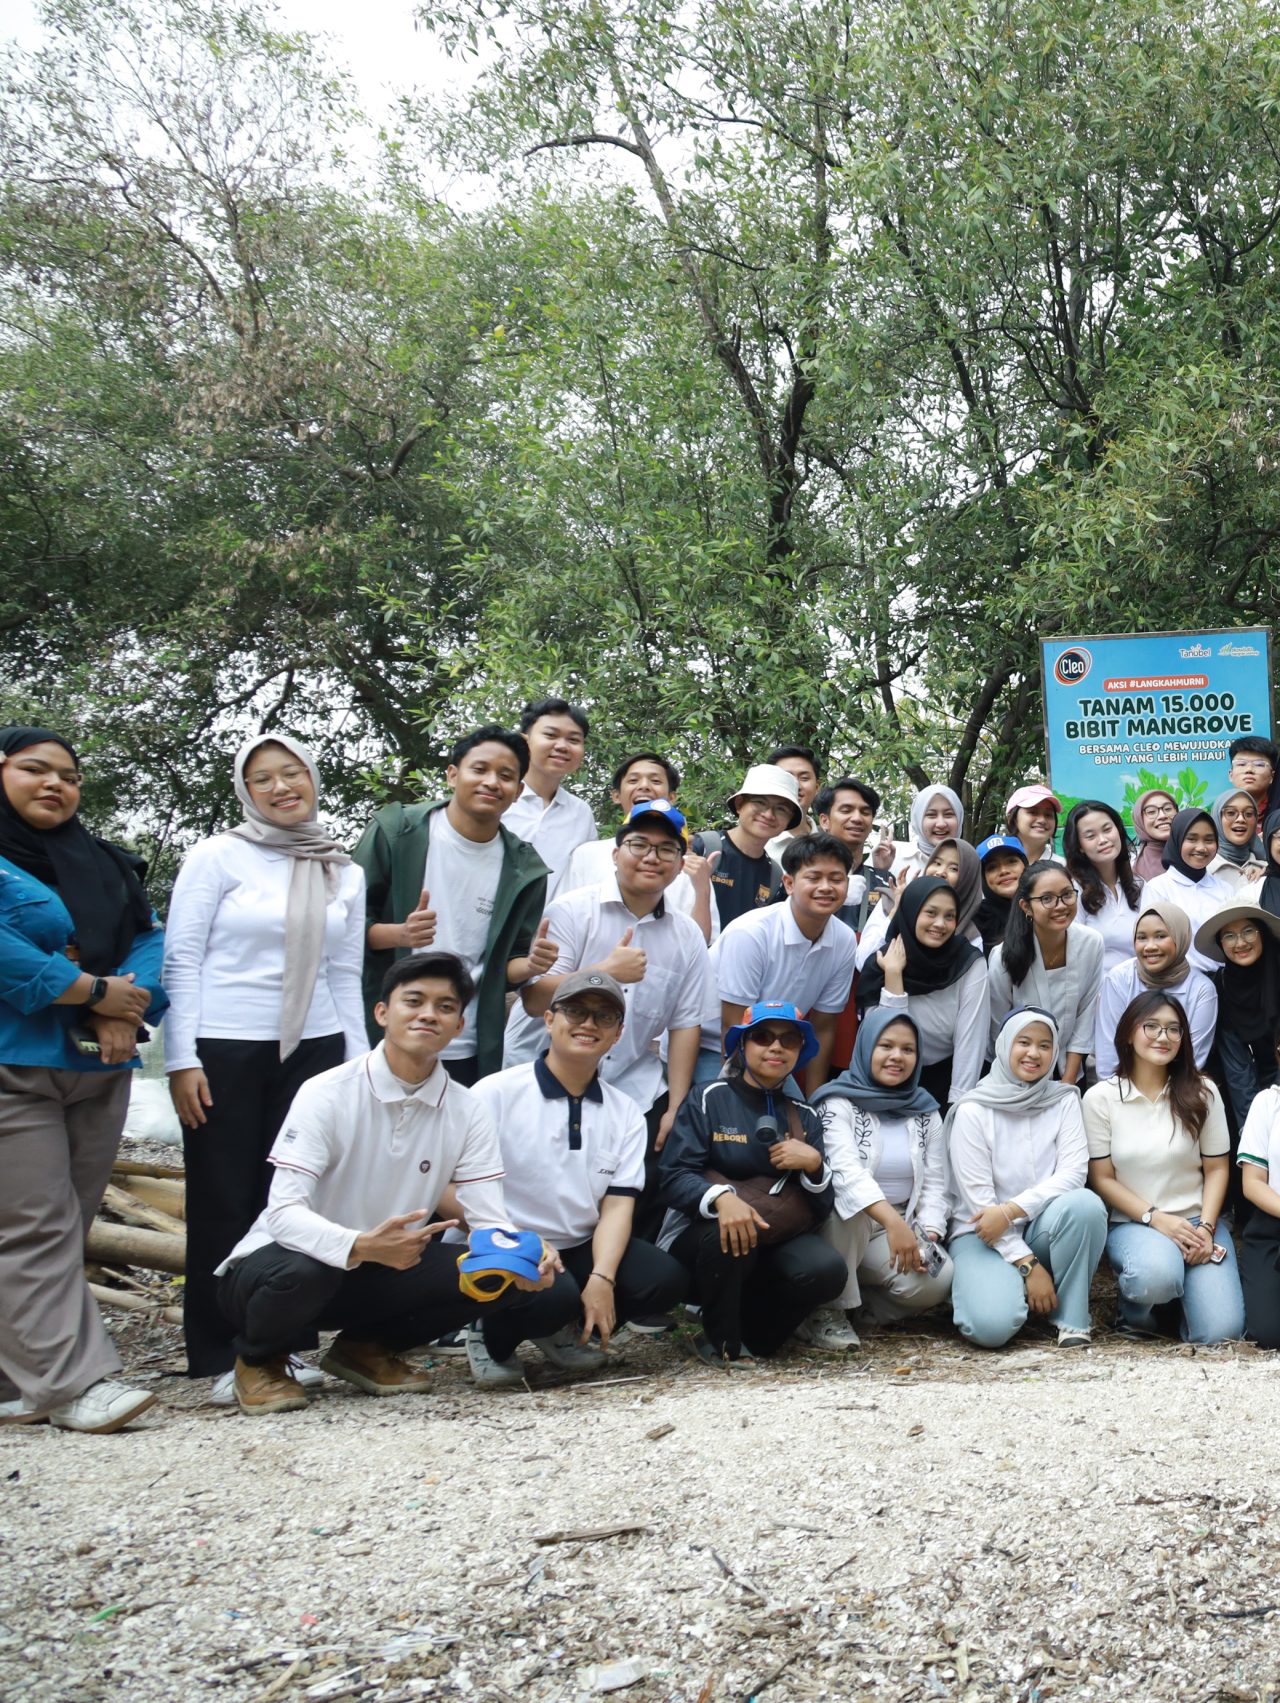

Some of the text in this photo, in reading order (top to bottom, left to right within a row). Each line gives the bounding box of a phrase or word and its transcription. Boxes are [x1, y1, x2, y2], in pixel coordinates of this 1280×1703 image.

[1062, 658, 1084, 674] Cleo
[1107, 678, 1204, 690] AKSI #LANGKAHMURNI
[1079, 693, 1235, 717] TANAM 15.000
[1065, 714, 1252, 739] BIBIT MANGROVE
[1079, 744, 1130, 755] BERSAMA
[1133, 742, 1160, 752] CLEO
[1094, 751, 1226, 765] BUMI YANG LEBIH HIJAU!
[713, 1131, 748, 1144] REBORN
